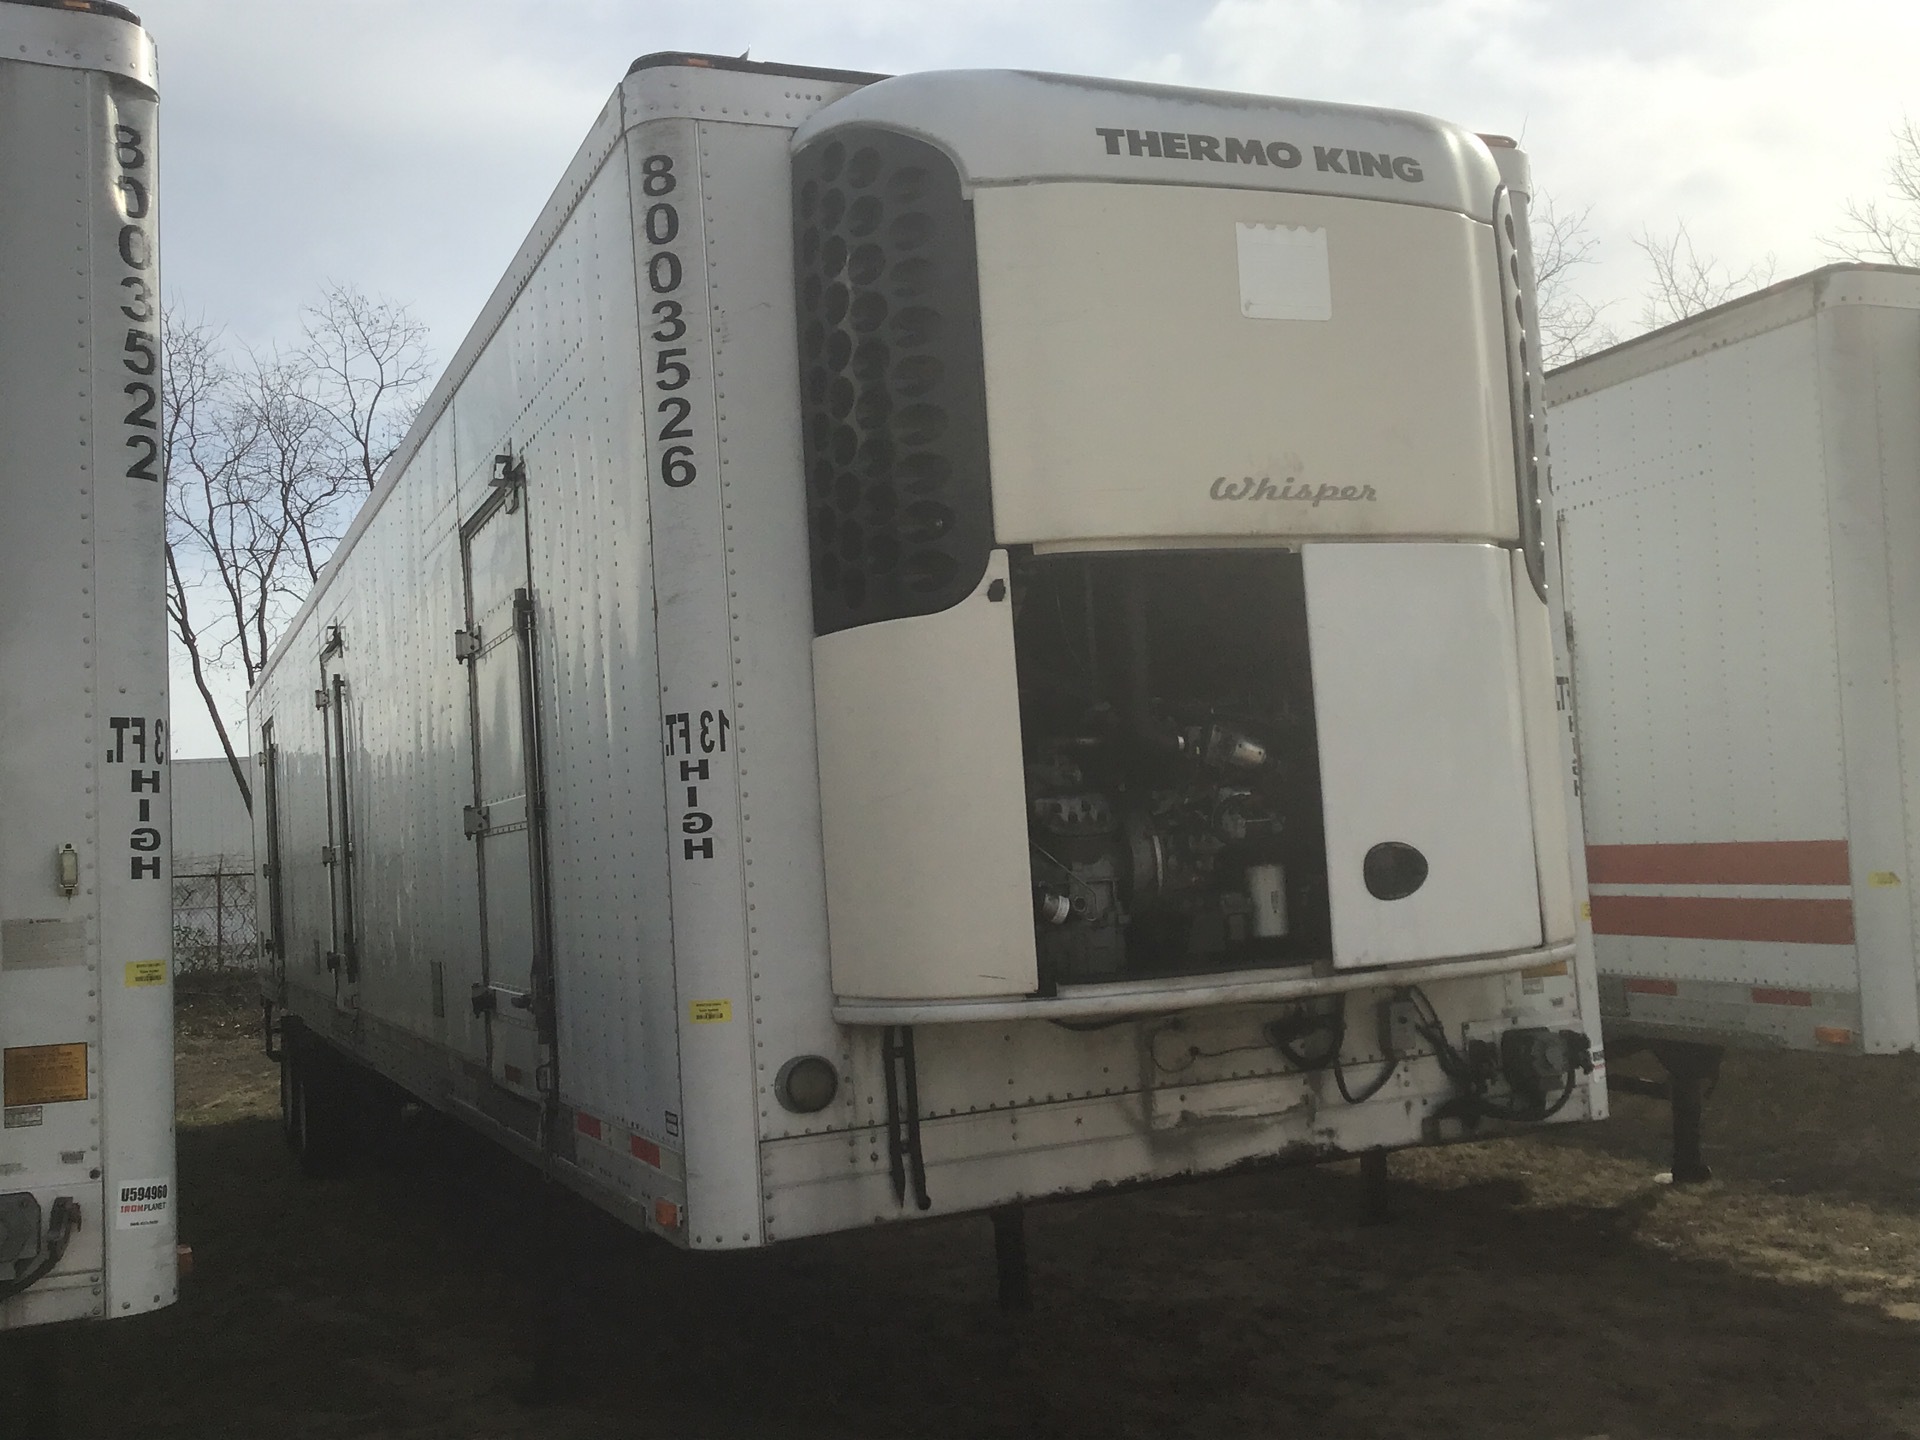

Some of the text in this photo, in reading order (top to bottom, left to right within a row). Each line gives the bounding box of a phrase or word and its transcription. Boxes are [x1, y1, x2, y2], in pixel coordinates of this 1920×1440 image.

[1095, 127, 1424, 183] THERMO KING
[114, 122, 159, 482] 8003522
[642, 154, 697, 488] 8003526
[1209, 476, 1377, 508] Whisper
[120, 1201, 167, 1214] IRONPLANET
[121, 1184, 168, 1203] U594960
